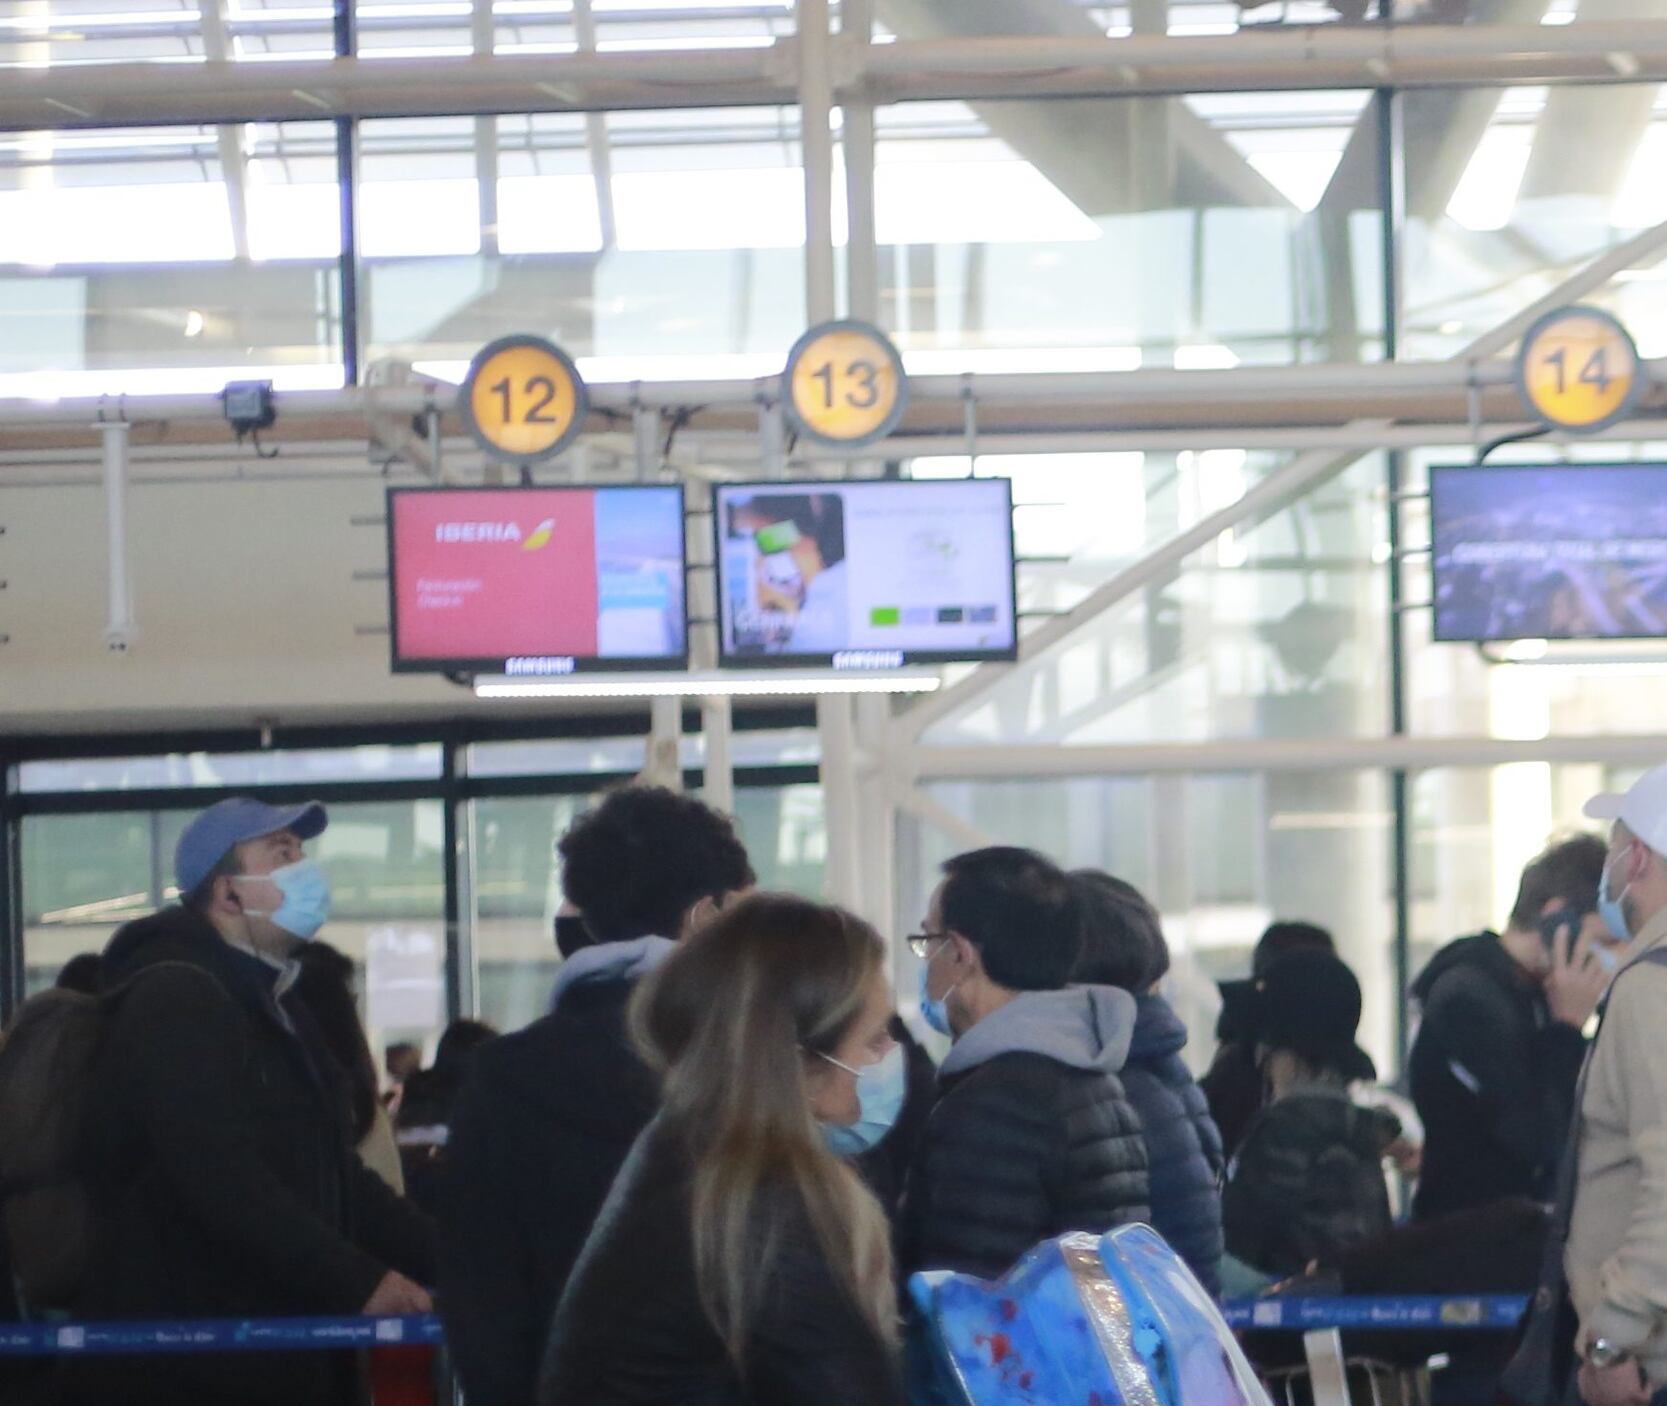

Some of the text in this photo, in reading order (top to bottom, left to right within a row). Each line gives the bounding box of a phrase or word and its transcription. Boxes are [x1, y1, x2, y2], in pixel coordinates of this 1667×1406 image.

[812, 361, 879, 408] 13
[1543, 346, 1612, 395] 14
[491, 375, 557, 424] 12
[435, 521, 522, 544] IBERIA
